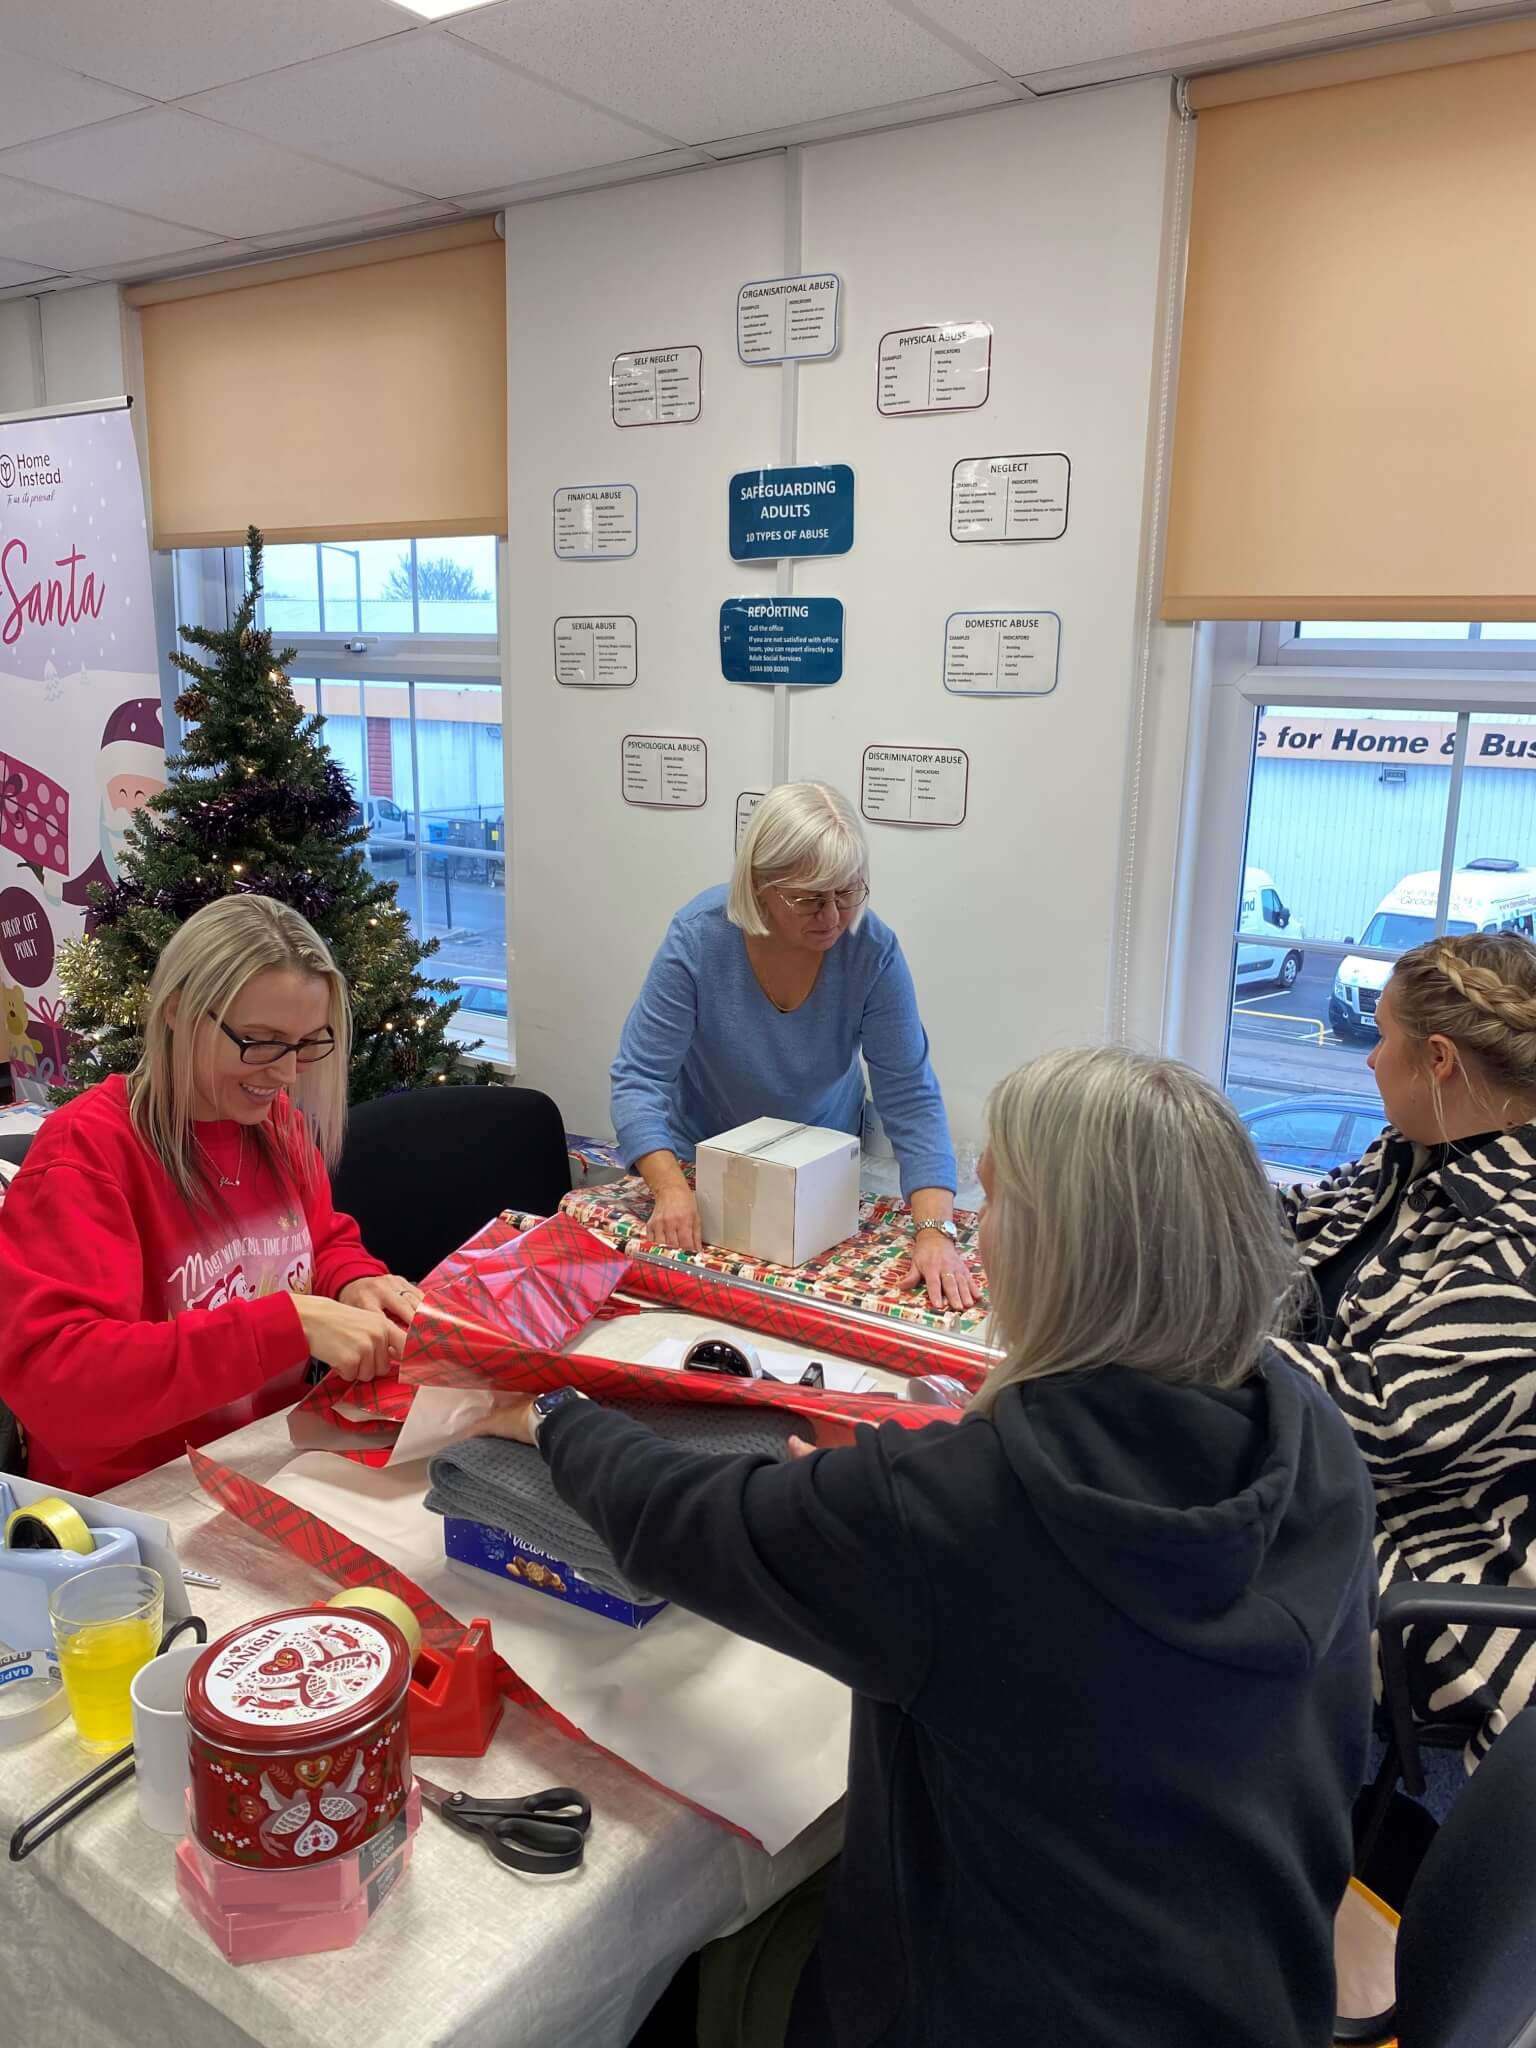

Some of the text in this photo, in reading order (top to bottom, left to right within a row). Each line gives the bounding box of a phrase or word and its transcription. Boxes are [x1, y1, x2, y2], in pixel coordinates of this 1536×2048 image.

[742, 280, 835, 299] ORGANISATIONAL ABUSE
[899, 334, 936, 347] PHYSICAL
[633, 353, 679, 366] SELF NEGLECT
[17, 454, 50, 469] Home
[990, 463, 1029, 473] NEGLECT
[19, 467, 61, 487] Instead
[567, 491, 622, 501] FINANCIAL ABUSE
[740, 481, 836, 501] SAFEGUARDING
[760, 504, 810, 519] ADULTS
[746, 529, 829, 542] 10 TYPES OF ABUSE
[2, 539, 105, 645] Santa
[747, 606, 809, 618] REPORTING
[572, 622, 594, 630] SEXUAL
[965, 619, 1039, 628] DOMESTIC ABUSE
[627, 741, 701, 752] PSYCHOLOGICAL ABUSE
[1277, 726, 1322, 749] for
[1331, 728, 1429, 754] Home
[1440, 732, 1456, 755] &
[868, 752, 963, 764] DISCRIMINATORY ABUSE
[1, 913, 38, 938] DROP OFF
[14, 939, 38, 960] POINT
[263, 1237, 280, 1257] TIME
[216, 1629, 282, 1680] DANISH
